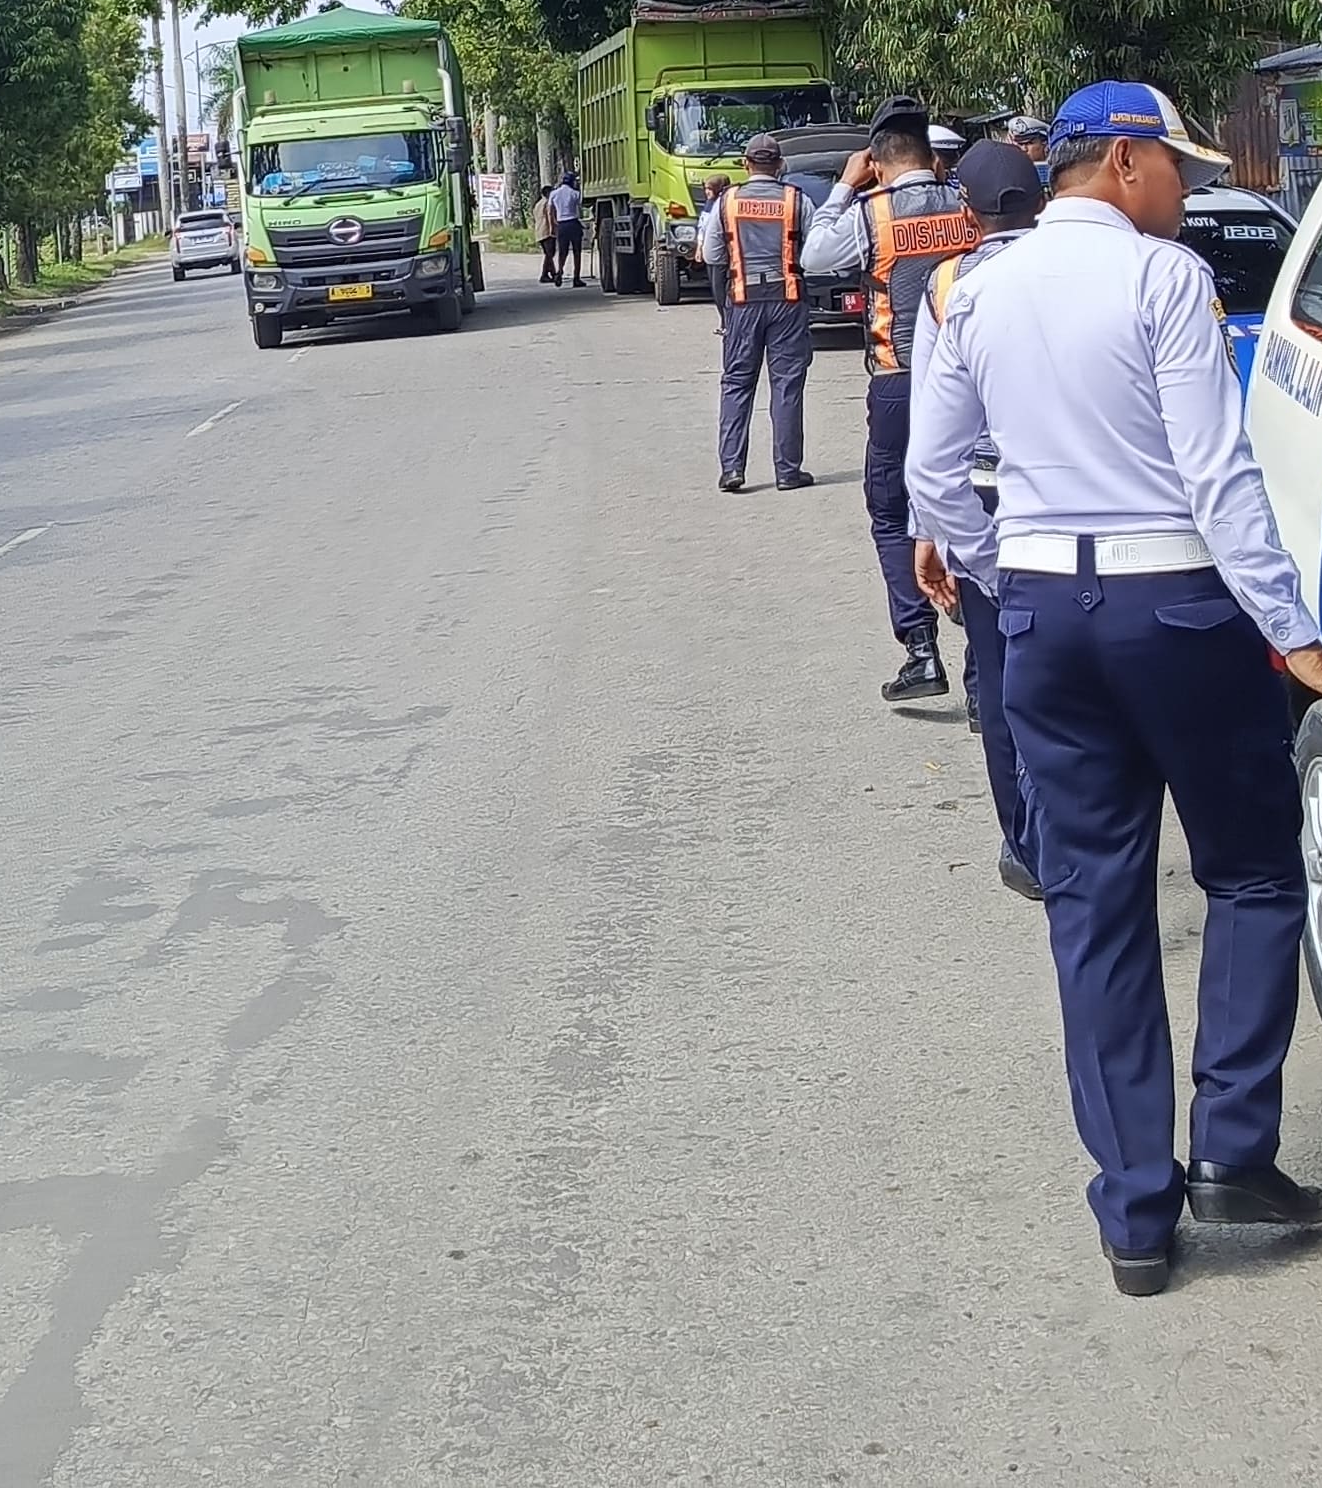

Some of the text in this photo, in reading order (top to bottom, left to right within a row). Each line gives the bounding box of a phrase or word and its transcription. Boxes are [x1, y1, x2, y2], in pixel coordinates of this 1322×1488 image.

[737, 201, 784, 217] DISHUB
[268, 219, 302, 227] HINO
[1186, 217, 1218, 227] KOTA
[892, 217, 977, 252] DISHUB
[1224, 226, 1277, 240] 1202
[845, 295, 857, 305] BA
